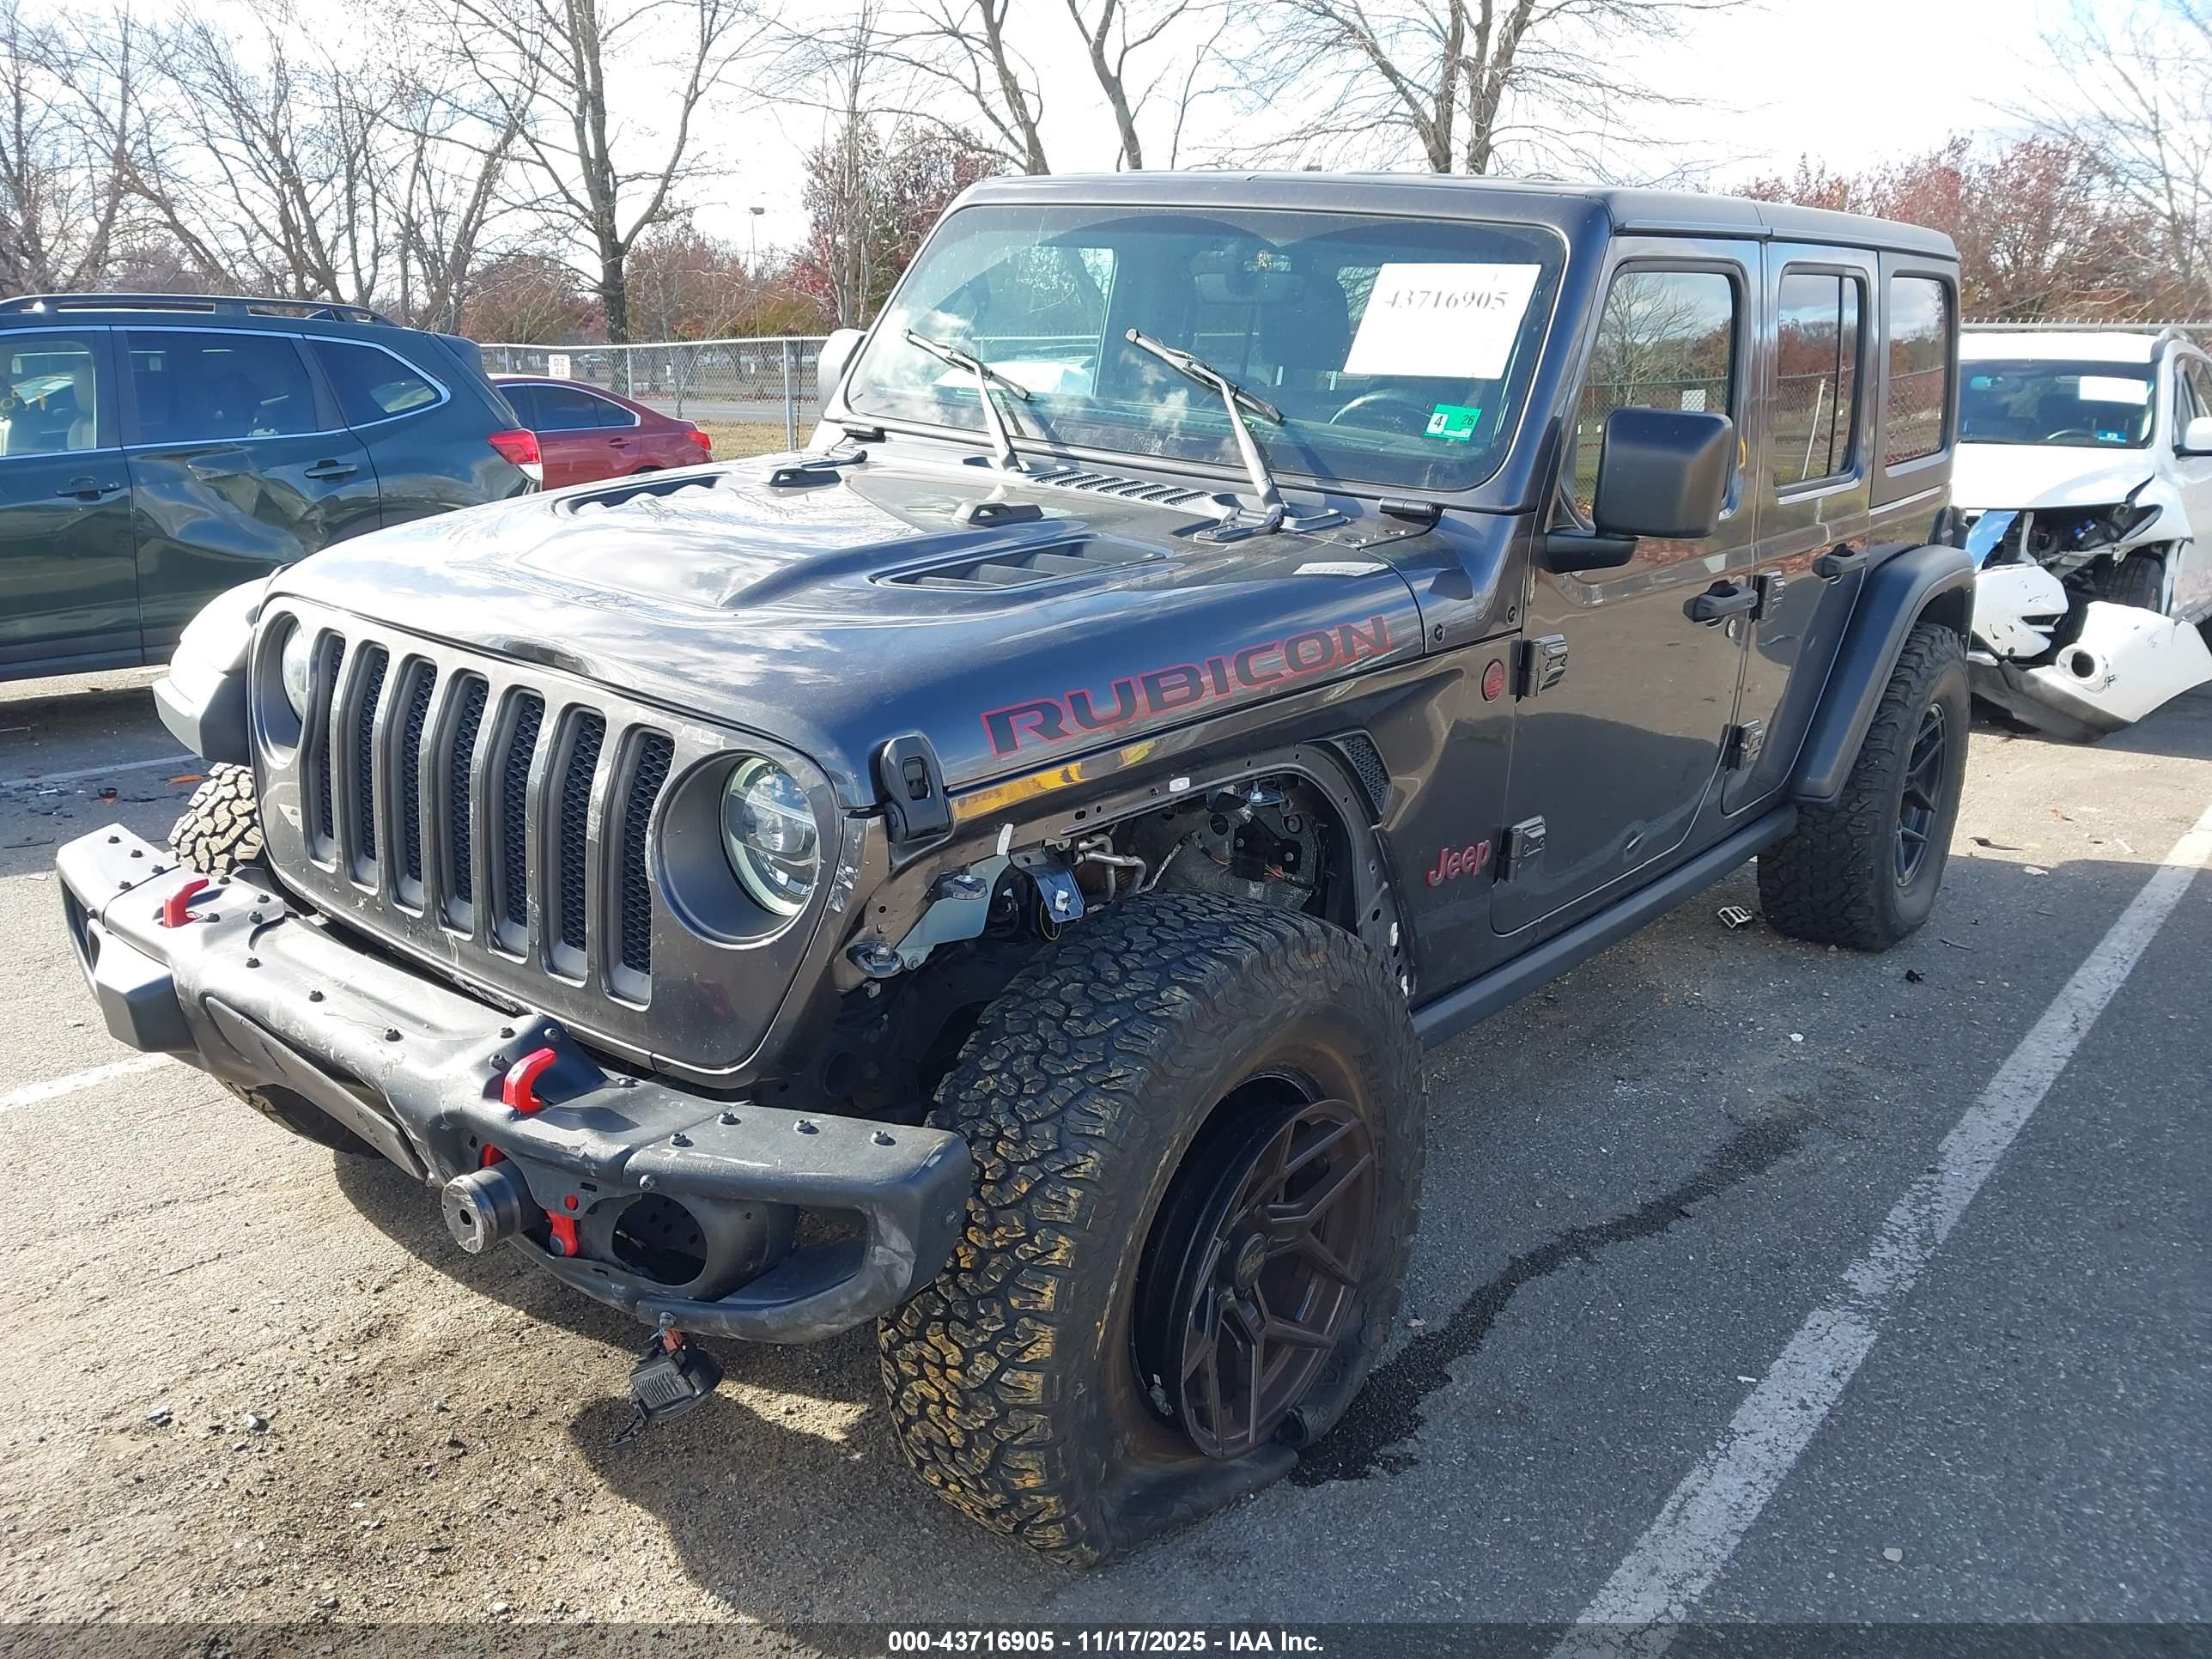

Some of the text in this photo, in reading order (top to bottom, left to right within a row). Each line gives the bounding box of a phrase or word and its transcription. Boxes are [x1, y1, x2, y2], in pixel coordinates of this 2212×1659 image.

[1385, 289, 1509, 310] 43716905
[1433, 413, 1476, 428] 4 26
[981, 614, 1391, 758] RUBICON
[1425, 838, 1492, 886] Jeep
